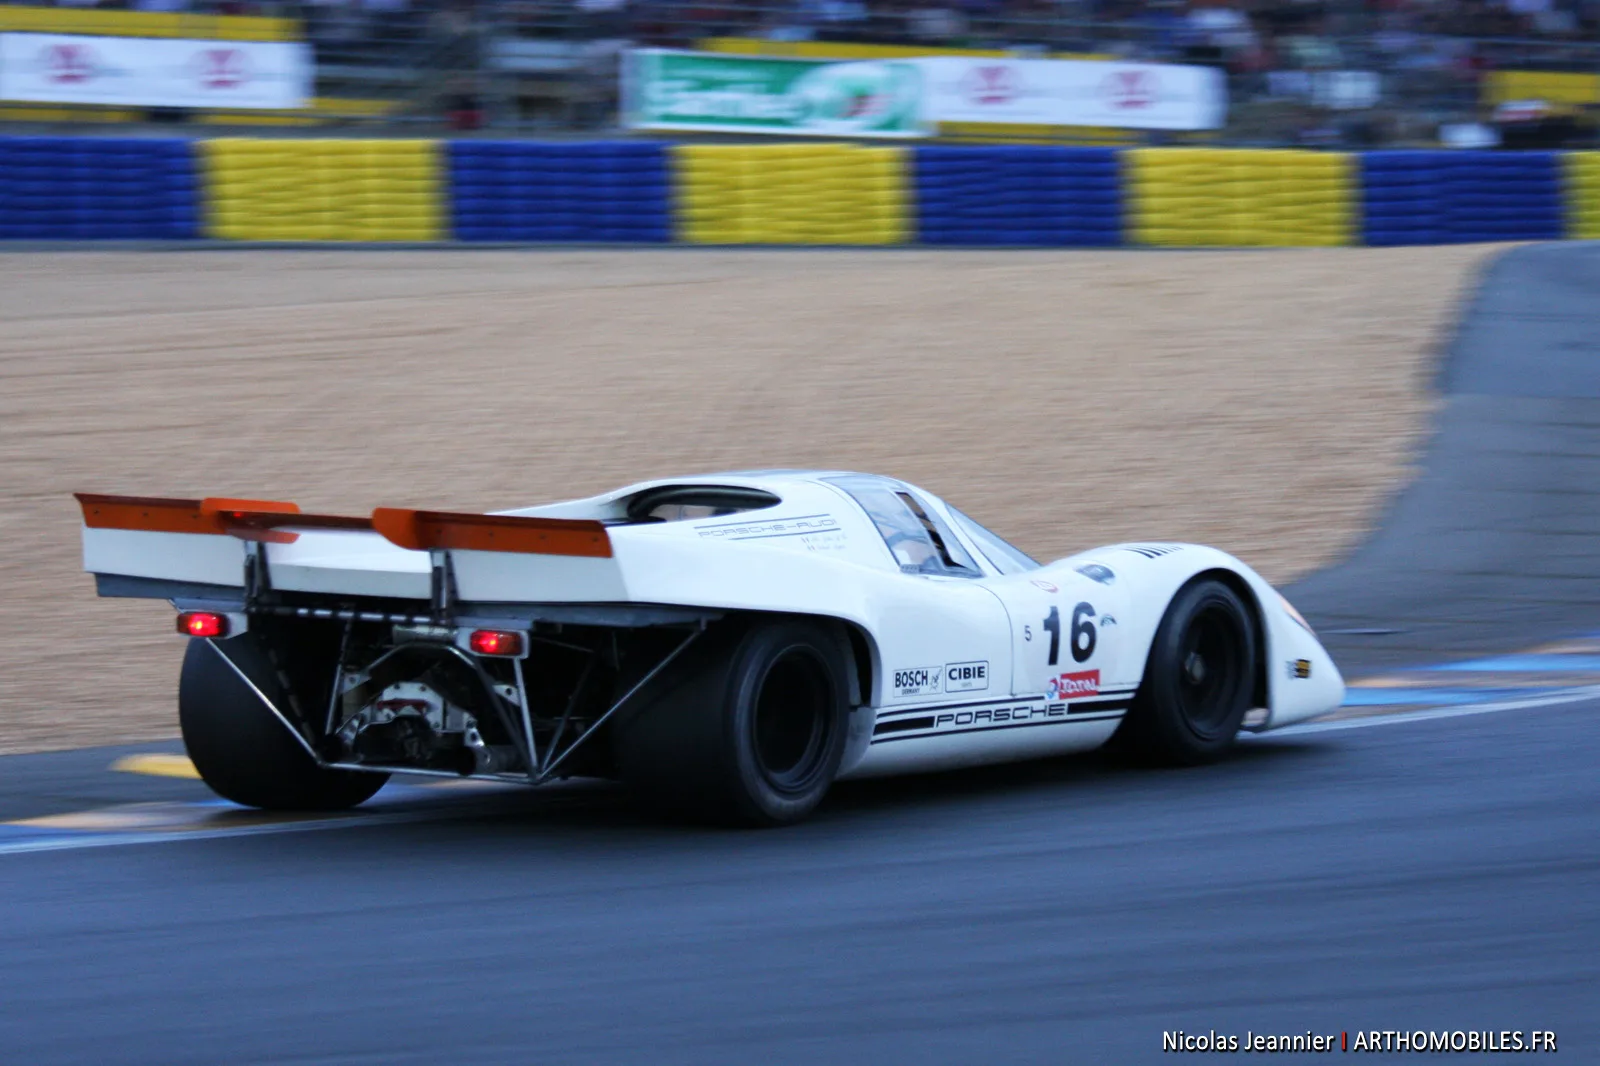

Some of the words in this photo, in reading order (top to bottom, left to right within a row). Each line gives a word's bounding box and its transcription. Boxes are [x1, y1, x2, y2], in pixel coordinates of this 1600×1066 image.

[698, 519, 837, 537] PORSCHE-AUDI
[1024, 625, 1032, 642] 5
[1043, 601, 1097, 666] 16
[895, 670, 928, 688] BOSCH
[948, 666, 985, 681] CIBIE
[935, 703, 1067, 727] PORSCHE
